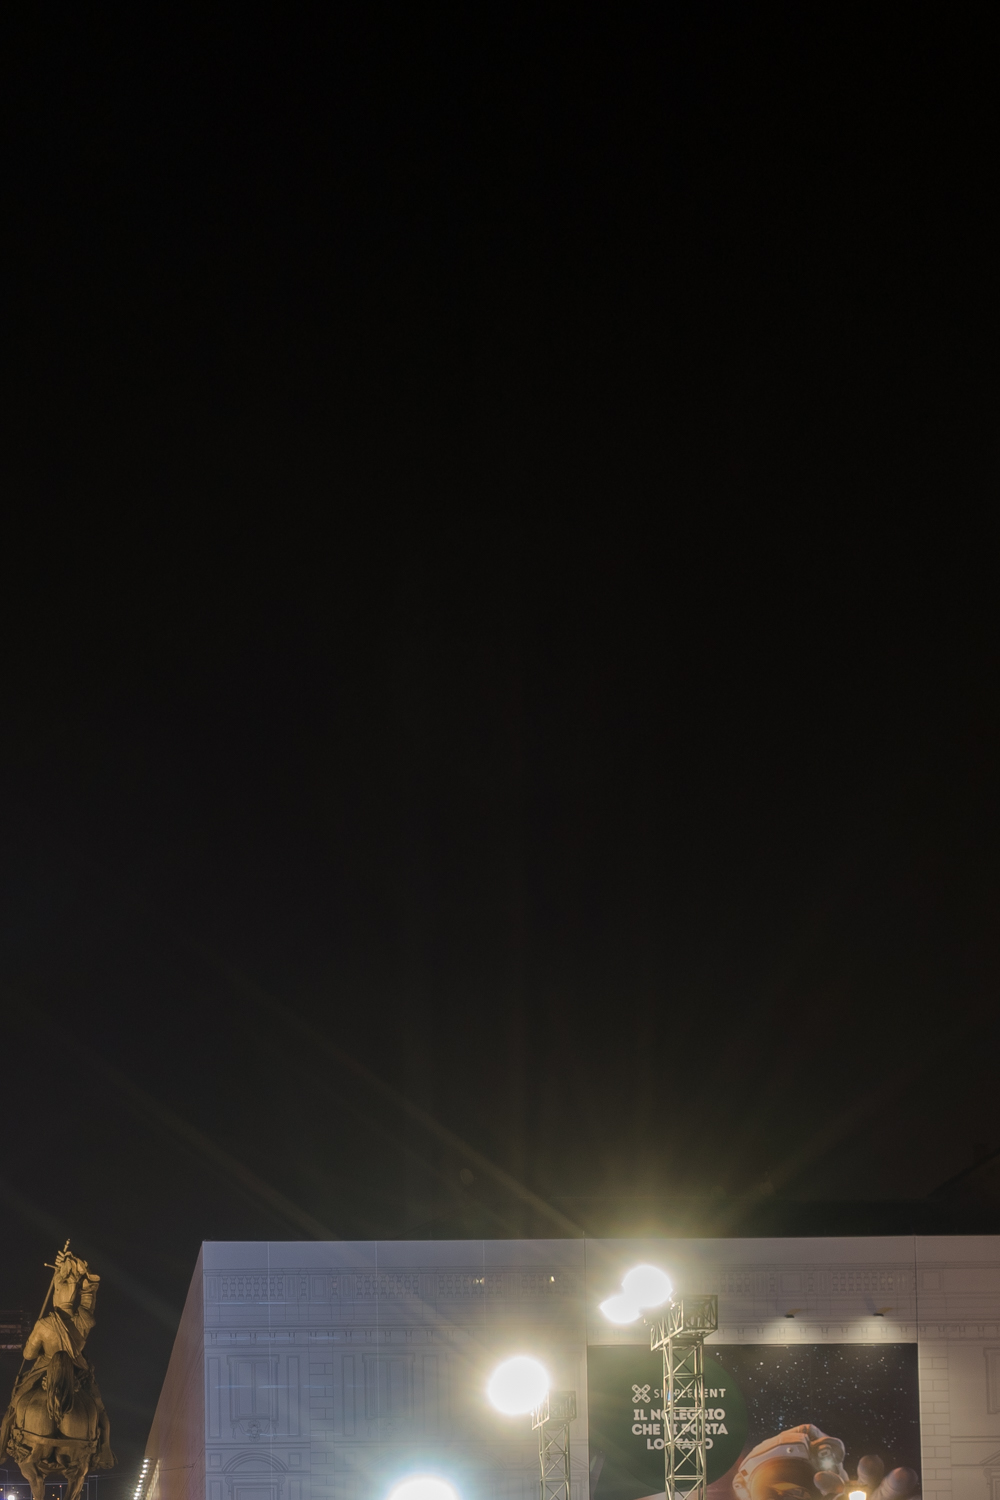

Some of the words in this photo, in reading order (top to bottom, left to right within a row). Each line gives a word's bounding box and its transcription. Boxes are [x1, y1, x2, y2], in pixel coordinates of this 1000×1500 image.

[633, 1409, 648, 1420] IL
[631, 1423, 661, 1435] CHE
[680, 1423, 729, 1435] PORTA
